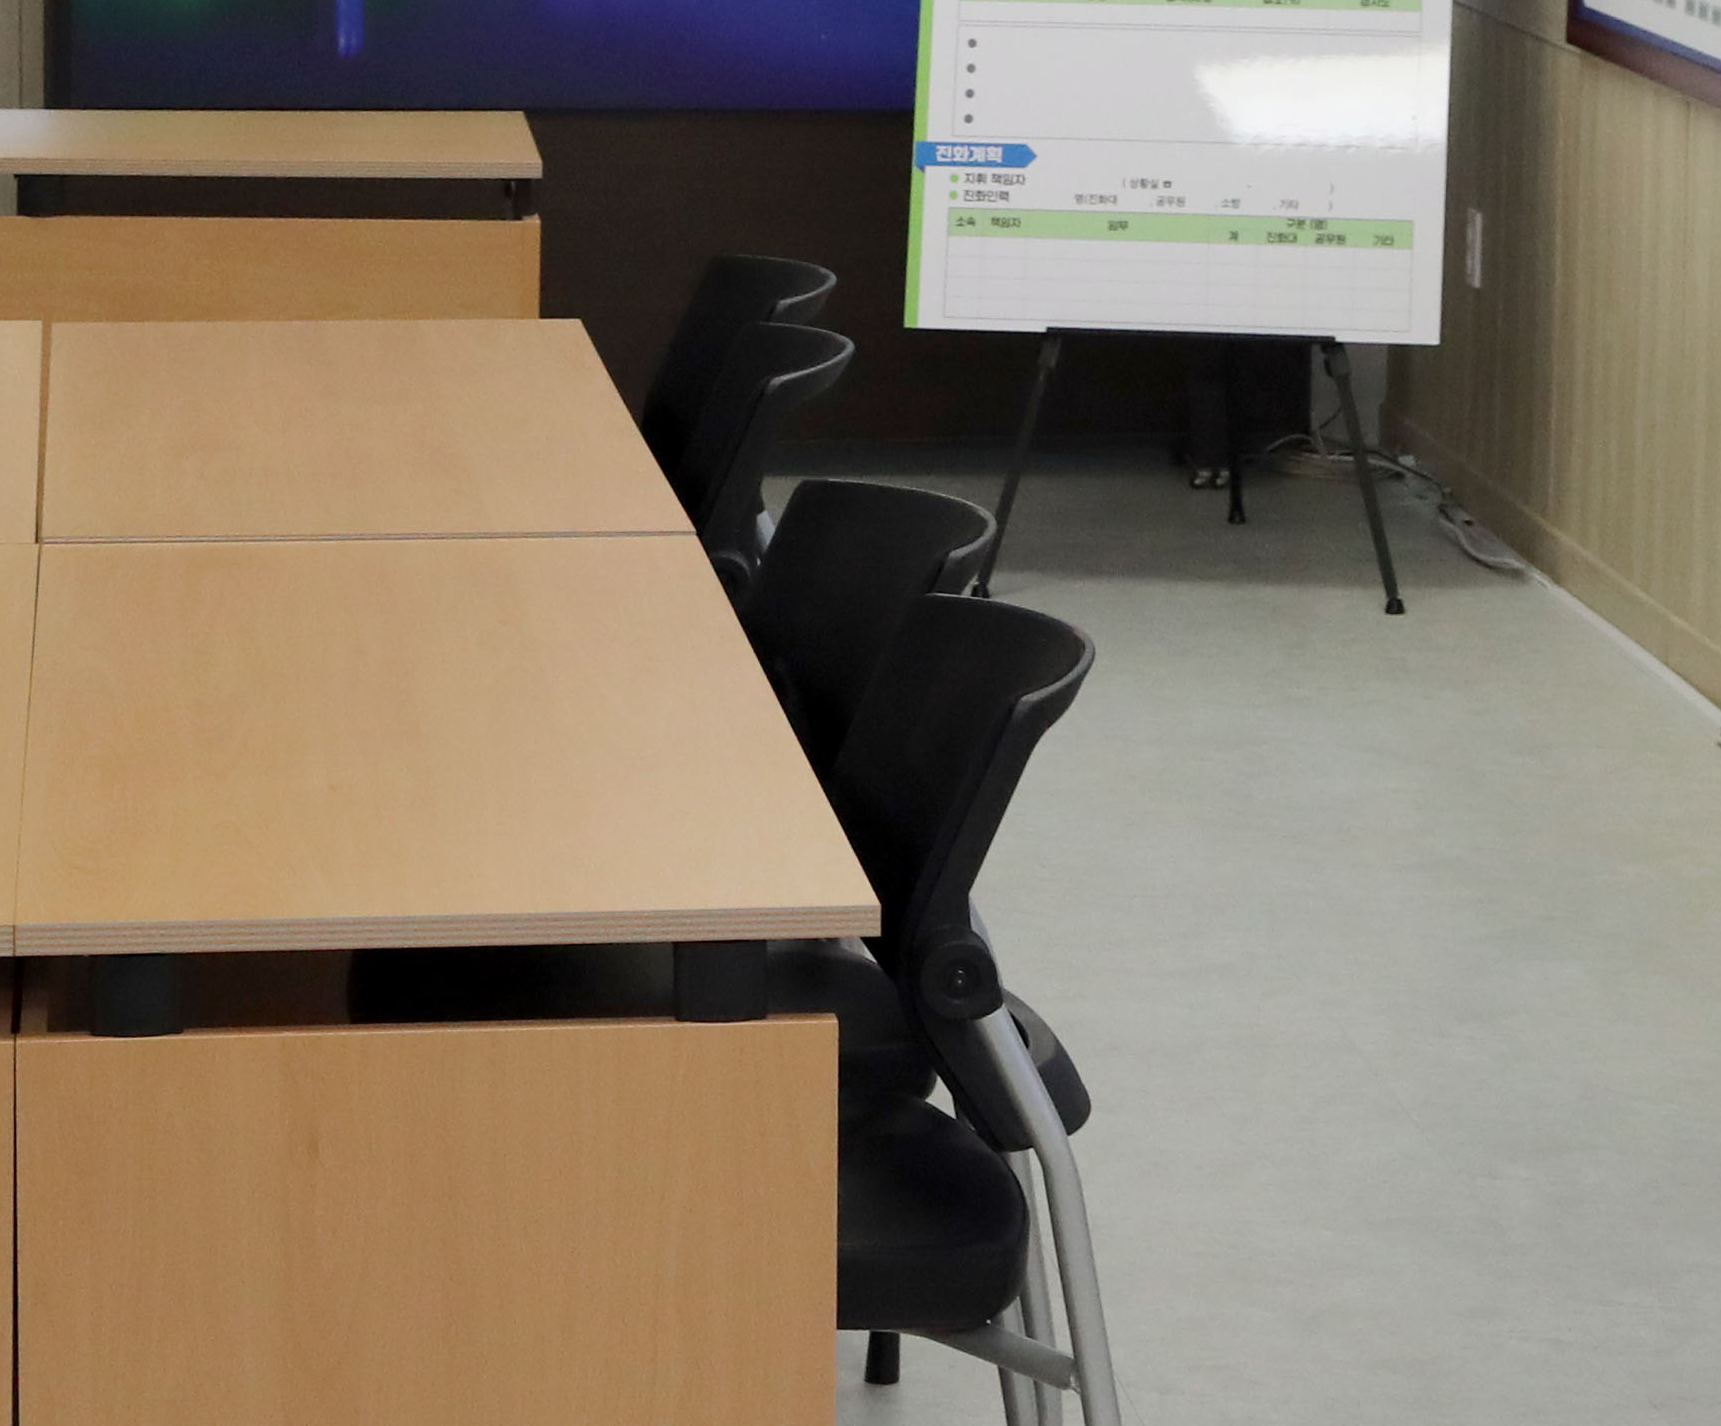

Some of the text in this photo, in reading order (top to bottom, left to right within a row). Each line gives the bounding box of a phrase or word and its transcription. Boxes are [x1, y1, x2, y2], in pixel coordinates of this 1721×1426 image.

[935, 145, 1004, 164] 진화계획
[991, 173, 1026, 187] 책임자
[962, 189, 1010, 203] 진화인력
